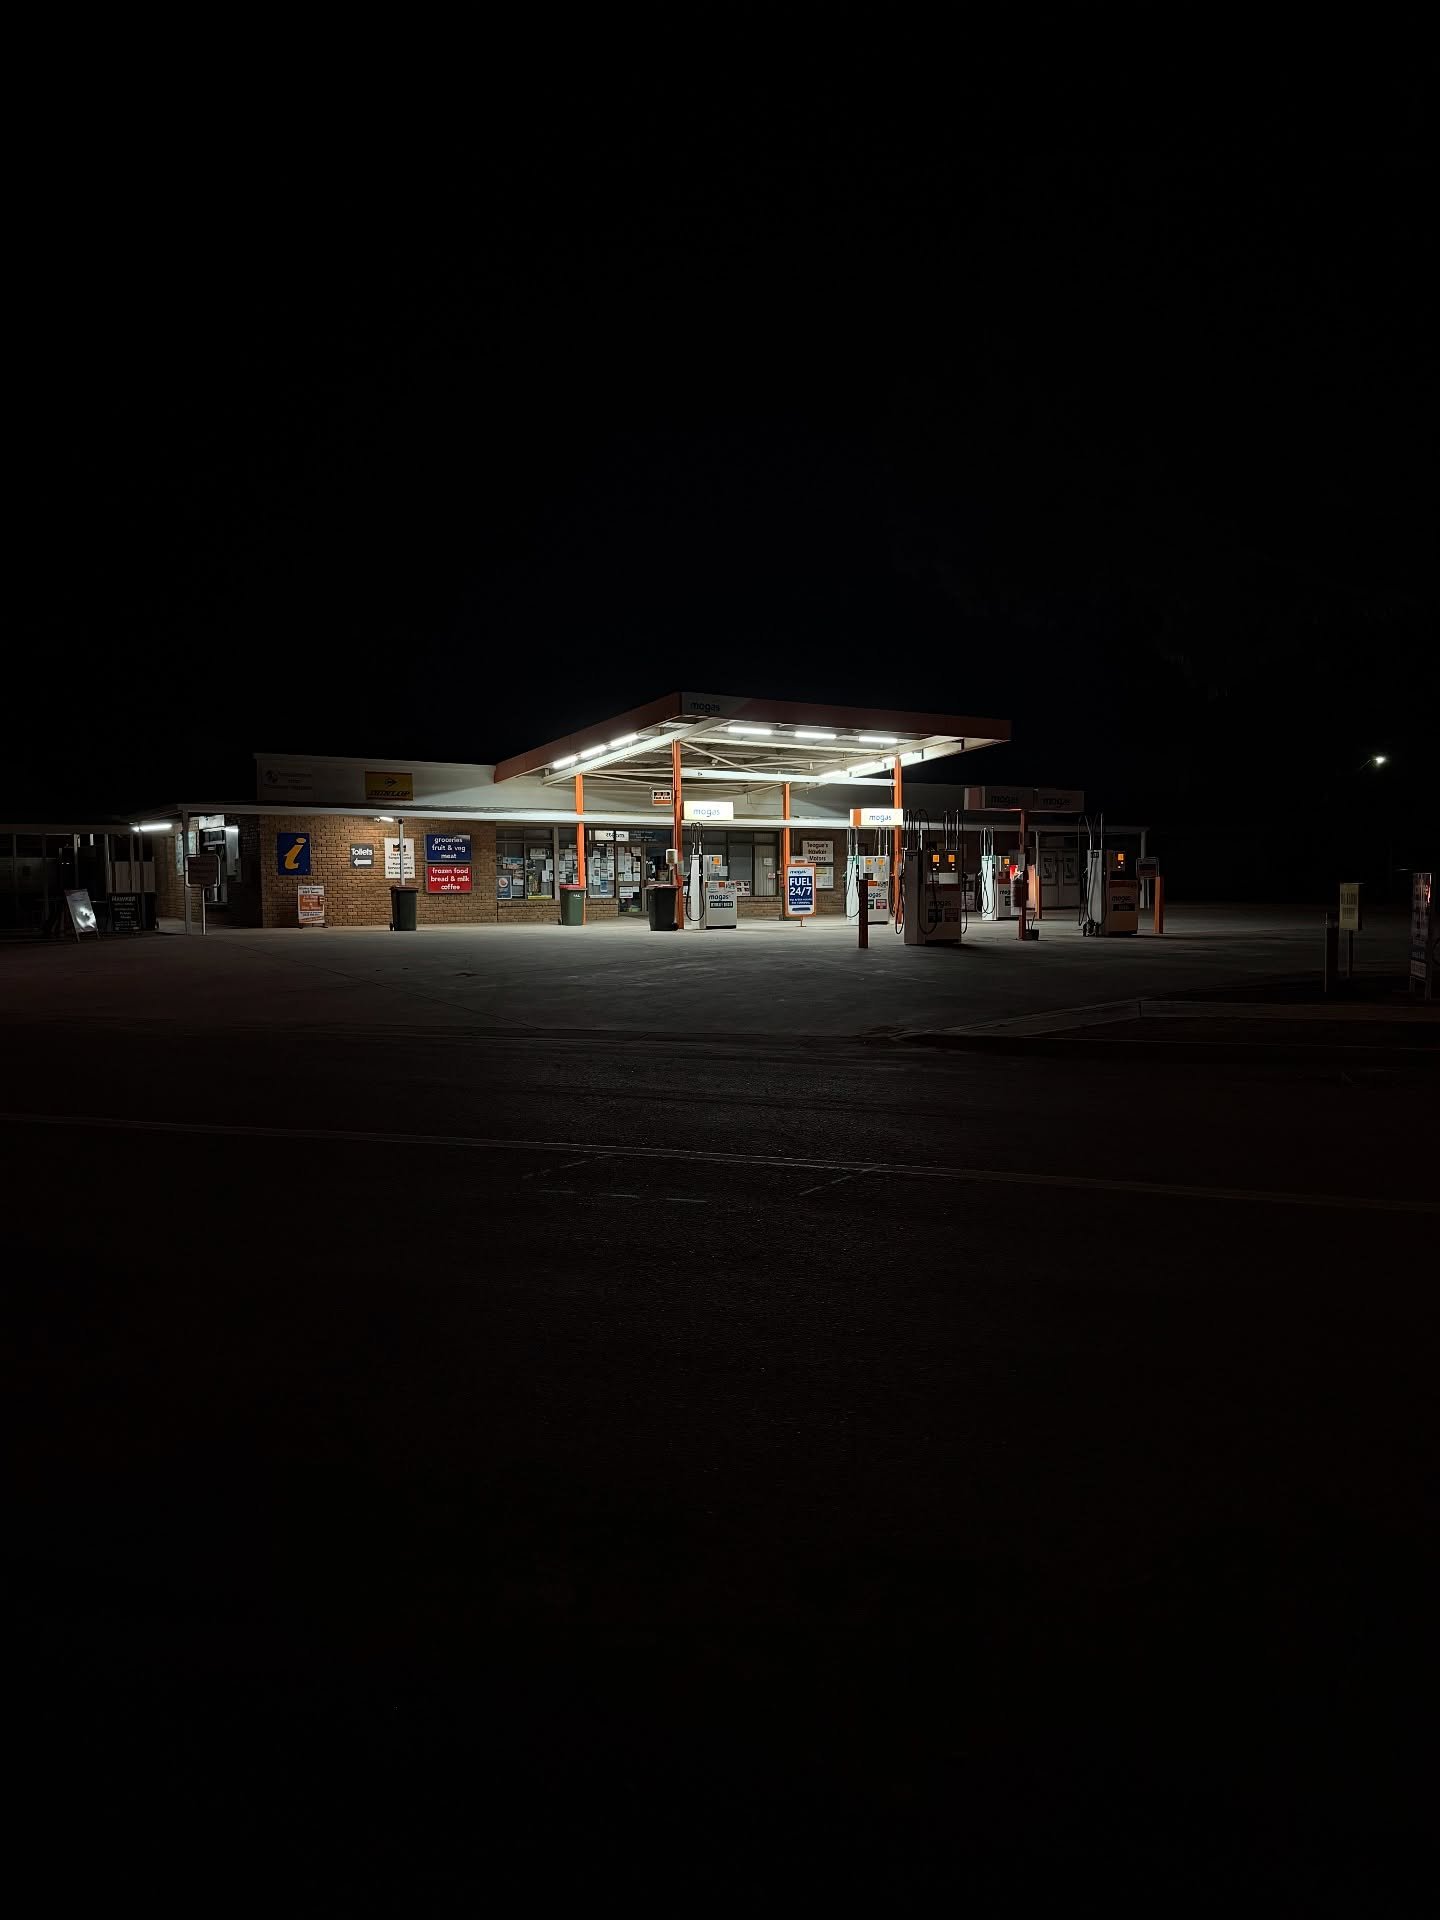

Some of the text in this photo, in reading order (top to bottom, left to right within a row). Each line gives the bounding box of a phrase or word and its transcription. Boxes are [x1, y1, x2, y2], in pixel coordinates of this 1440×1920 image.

[690, 702, 721, 713] mogas
[370, 789, 411, 797] DUNLOP
[693, 808, 720, 818] mogas
[869, 815, 892, 823] mogas
[807, 841, 829, 849] Teague's
[351, 848, 373, 856] Toilets
[789, 877, 812, 886] FUEL
[789, 887, 812, 897] 24/7
[708, 893, 730, 901] mogas
[928, 900, 952, 908] mogas
